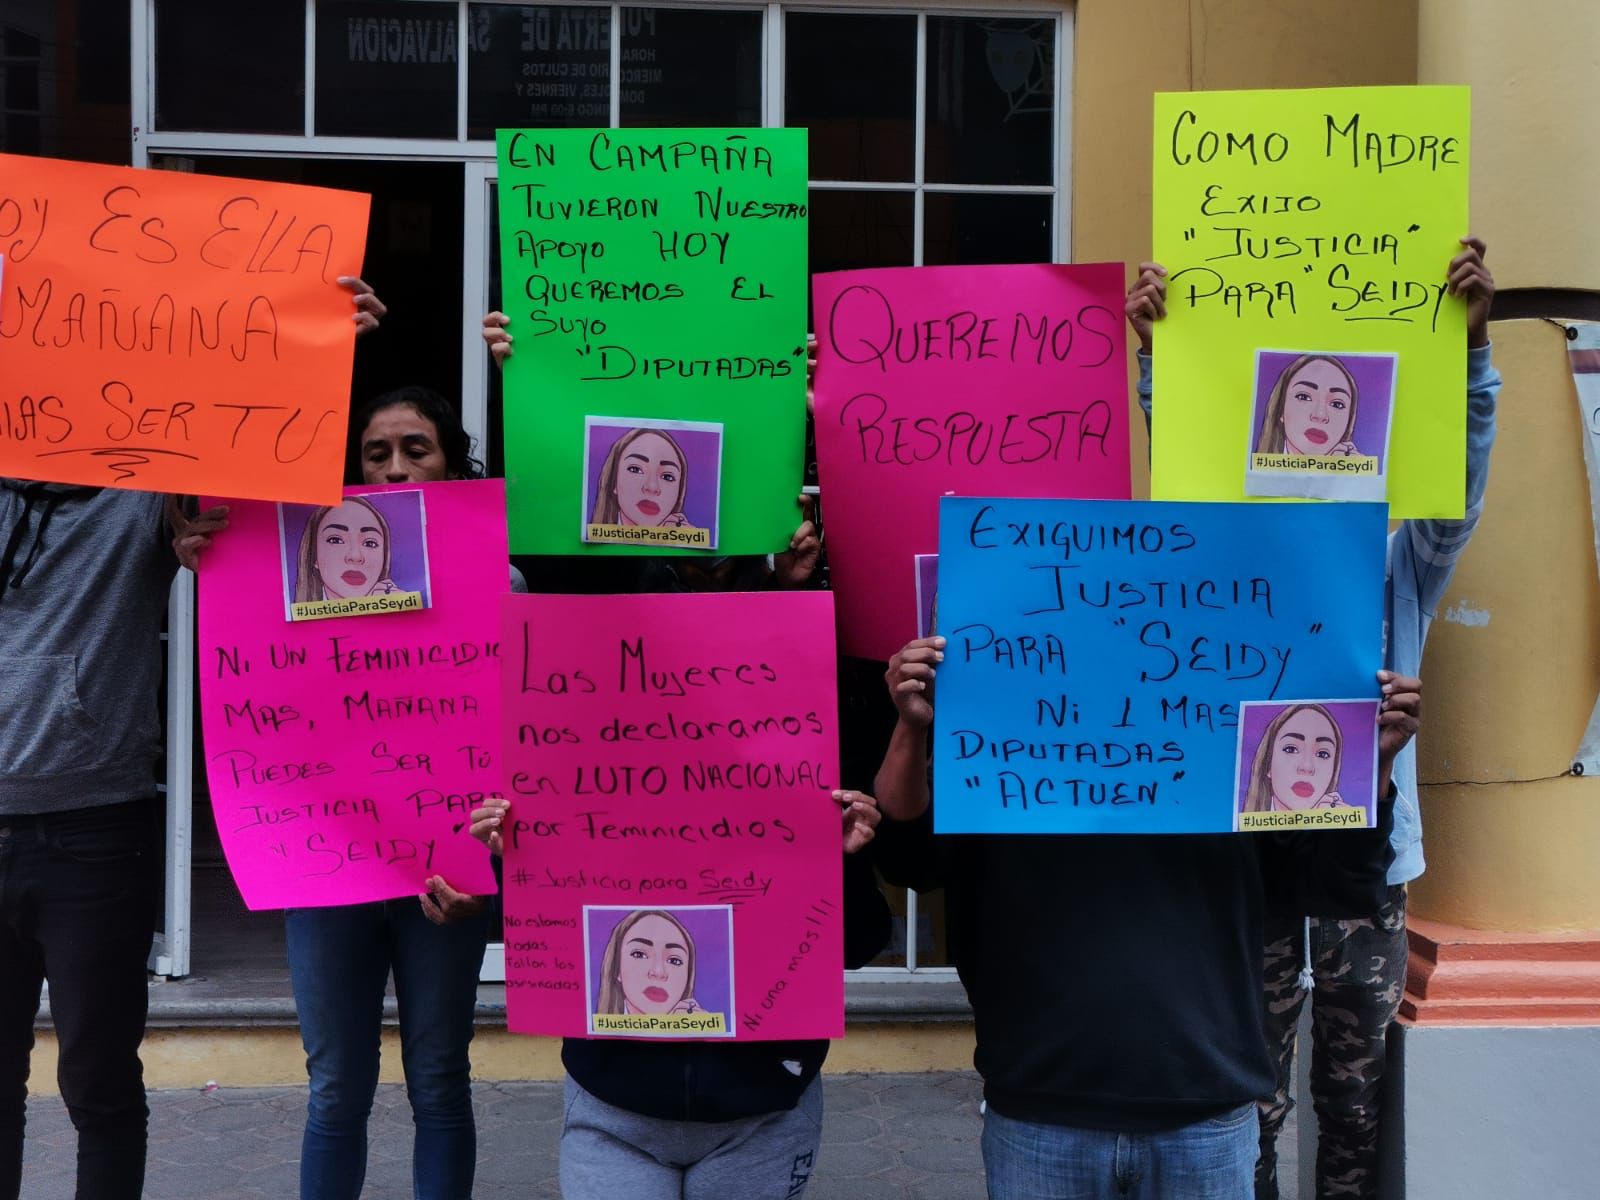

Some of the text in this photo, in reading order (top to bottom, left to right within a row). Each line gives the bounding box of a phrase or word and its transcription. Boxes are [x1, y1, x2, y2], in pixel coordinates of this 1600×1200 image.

[509, 132, 772, 177] EN CAMPAÑA
[1172, 110, 1459, 173] COMO MADRE
[512, 184, 807, 222] TUVIERON NUESTRO
[1200, 185, 1321, 216] EXIJO
[90, 186, 177, 263] ES
[200, 197, 334, 285] ELLA
[514, 231, 730, 273] APOYO HOY
[1182, 224, 1420, 265] "JUSTICIA"
[525, 275, 774, 306] QUEREMOS EL
[1170, 267, 1297, 318] PARA
[0, 278, 278, 361] MAÑANA
[530, 310, 606, 341] SUYO
[830, 285, 1117, 373] QUEREMOS
[576, 344, 804, 380] "DIPUTADAS"
[0, 381, 337, 463] IAS SER TU
[840, 393, 1112, 466] RESPUESTA
[1256, 457, 1373, 473] #JusticiaParaSeydi
[592, 527, 705, 544] #JusticiaParaSeydi
[969, 505, 1196, 560] EXIGUIMOS
[296, 595, 417, 617] #JusticiaParaSeydi
[1023, 565, 1274, 618] JUSTICIA
[270, 643, 306, 670] UN
[521, 621, 777, 697] Las Mujeres
[952, 617, 1324, 699] PARA "SEIDY"
[343, 691, 478, 725] MAÑANA
[1112, 696, 1136, 727] 1
[1162, 696, 1239, 733] MAS
[519, 712, 823, 747] nos declaramos
[212, 750, 335, 788] PUEDES
[371, 742, 434, 775] SER
[951, 730, 1185, 768] DIPUTADAS
[512, 760, 831, 795] en LUTO NACIONAL
[234, 798, 380, 834] JUSTICIA
[512, 811, 795, 849] por Feminicidios
[1244, 811, 1361, 827] #JusticiaParaSeydi
[639, 876, 688, 894] para
[699, 868, 772, 896] Seidy
[505, 913, 578, 929] No estamos
[554, 957, 575, 970] las
[761, 980, 788, 1010] una
[598, 1016, 720, 1032] #JusticiaParaSeydi
[785, 1149, 813, 1200] EA
